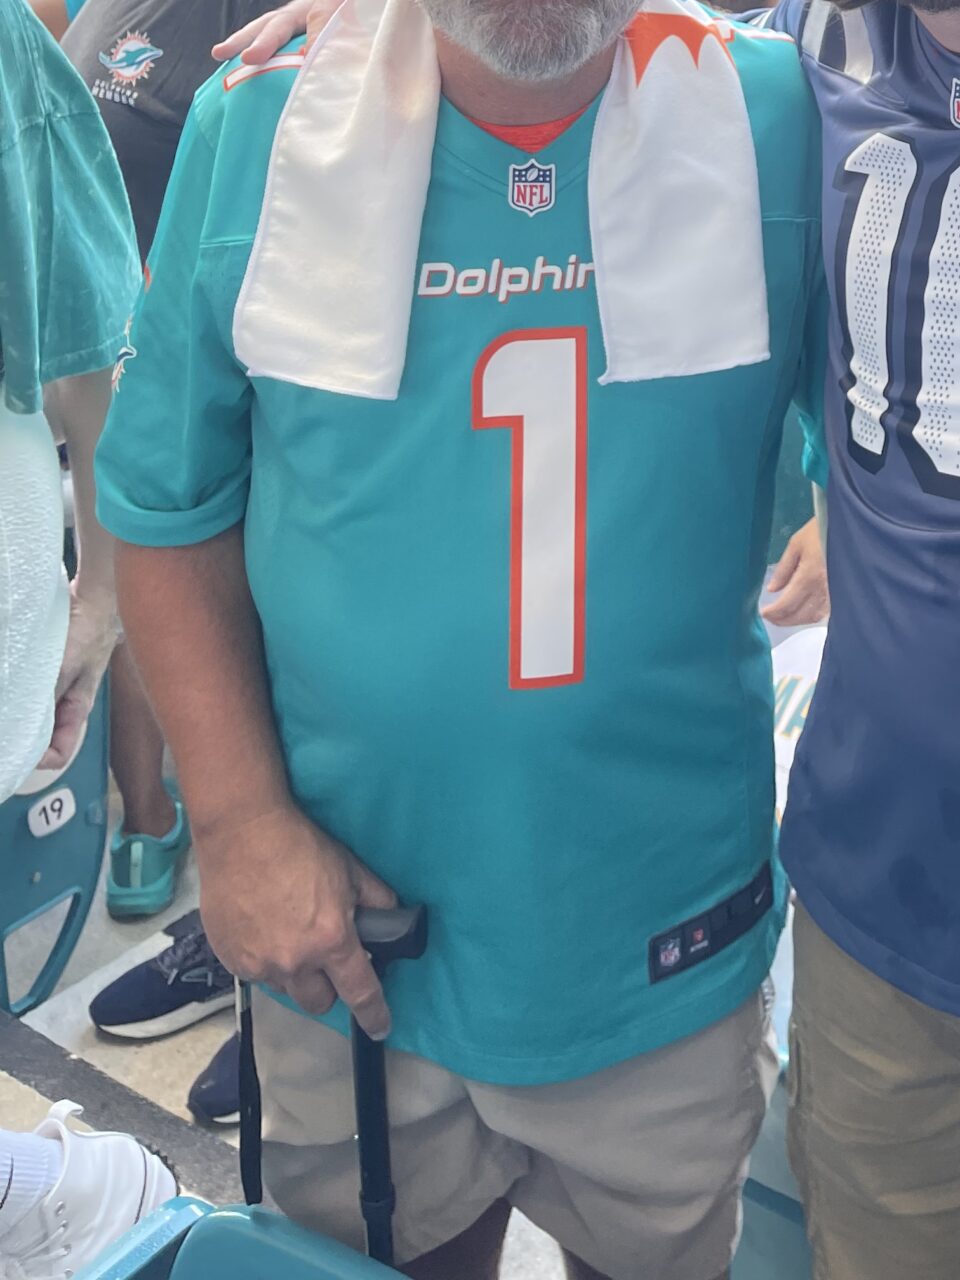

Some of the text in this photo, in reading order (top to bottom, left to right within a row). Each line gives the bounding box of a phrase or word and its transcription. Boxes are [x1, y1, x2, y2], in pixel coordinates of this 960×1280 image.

[91, 86, 135, 108] MEMBER
[516, 184, 548, 207] NFL
[418, 254, 595, 302] Dolphin
[471, 325, 588, 689] 1
[38, 798, 65, 827] 19
